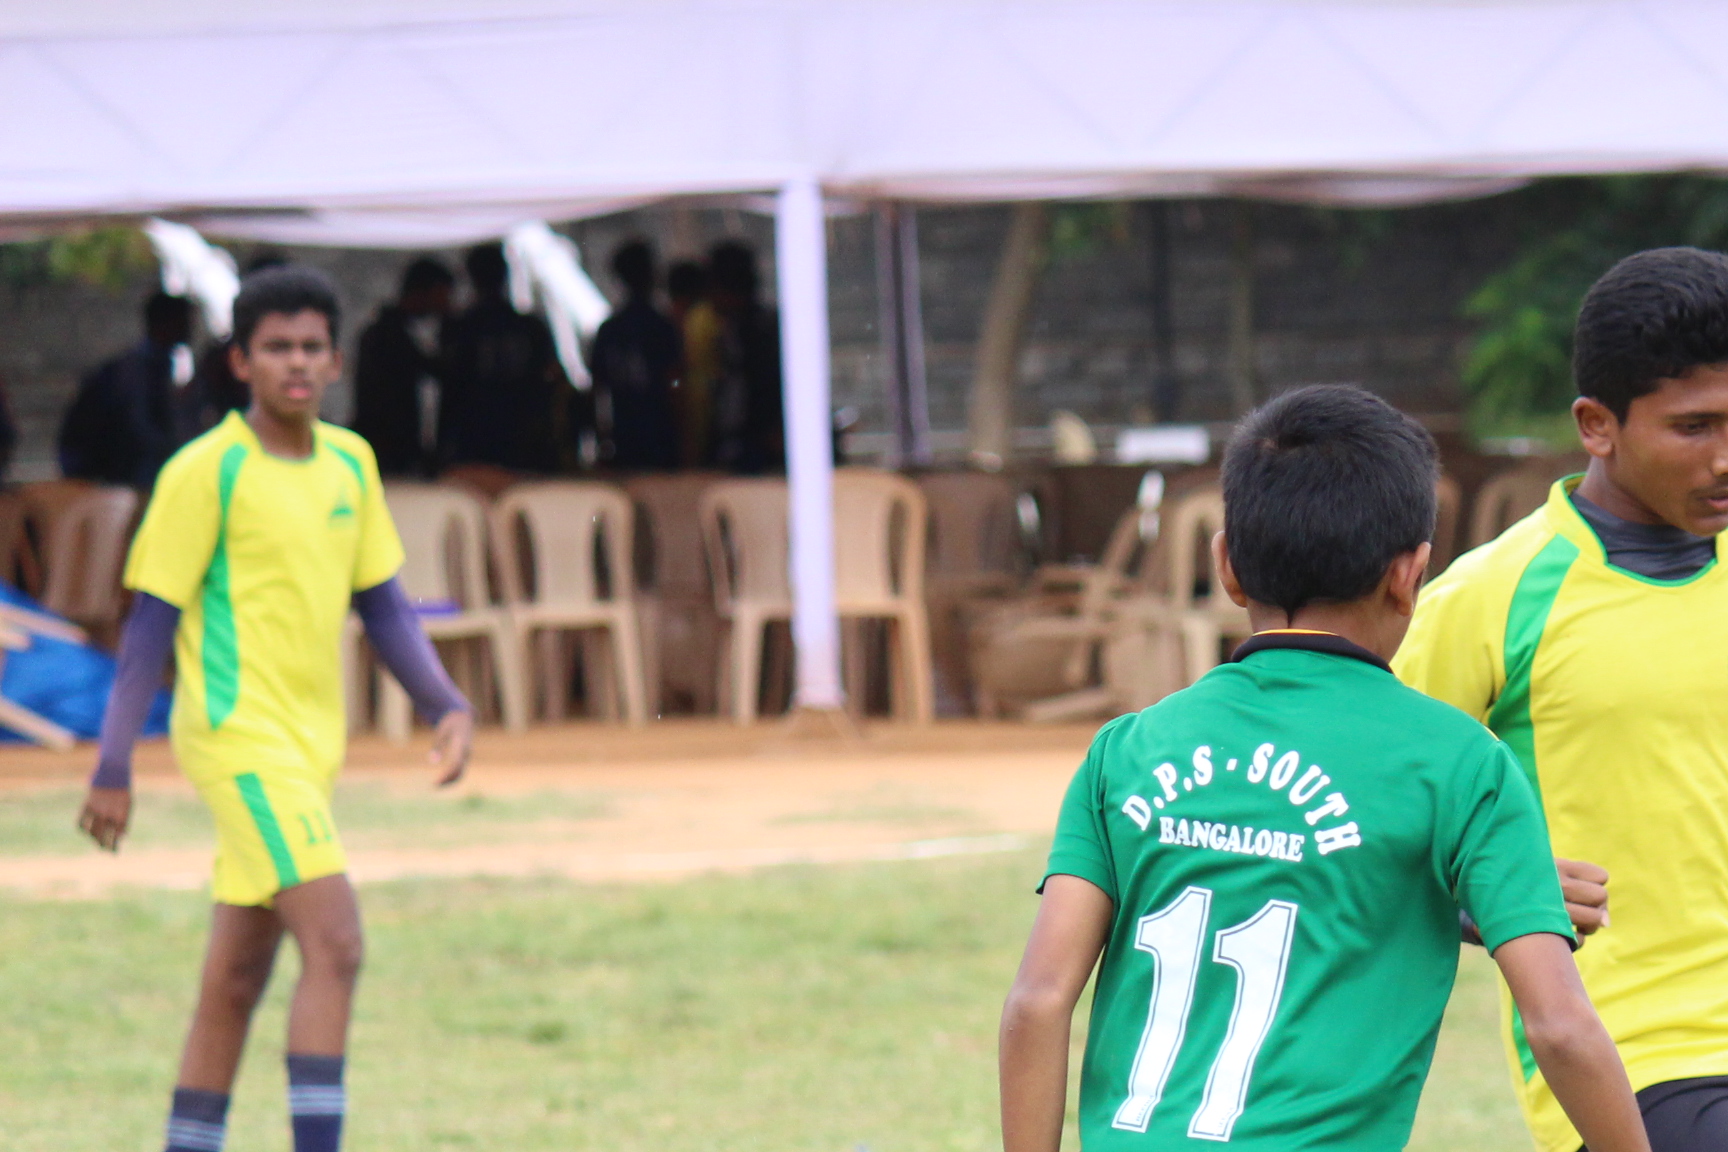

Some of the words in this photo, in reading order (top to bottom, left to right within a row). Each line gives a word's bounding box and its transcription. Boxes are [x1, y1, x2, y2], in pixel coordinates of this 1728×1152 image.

[1158, 815, 1306, 863] BANGALORE
[1246, 742, 1363, 856] SOUTH
[1111, 885, 1299, 1143] 11
